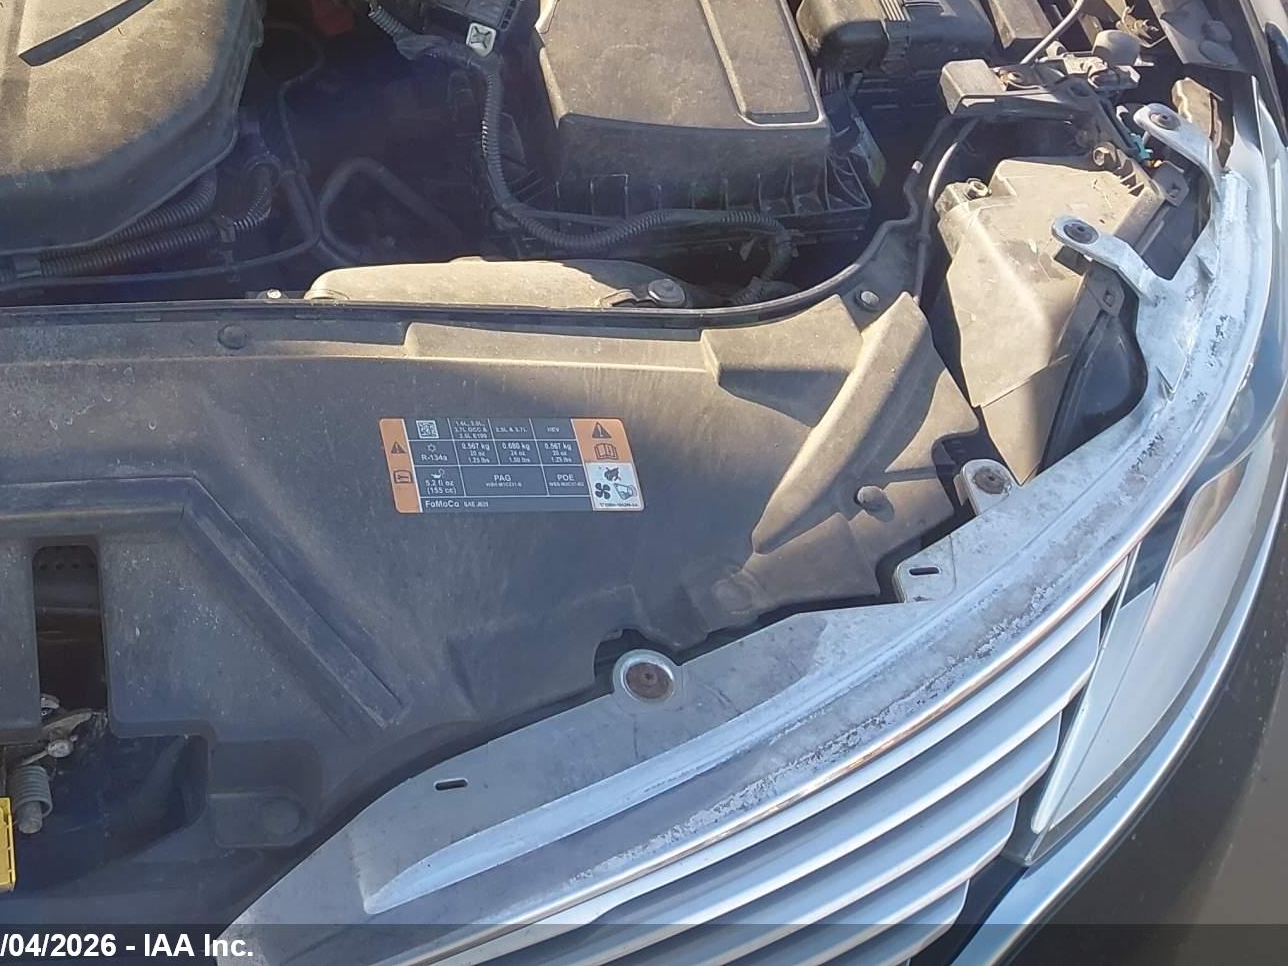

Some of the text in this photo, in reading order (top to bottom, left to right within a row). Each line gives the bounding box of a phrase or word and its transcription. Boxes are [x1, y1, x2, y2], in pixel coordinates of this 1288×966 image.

[481, 442, 490, 451] kg
[521, 442, 531, 450] kg
[562, 442, 572, 450] kg
[494, 474, 512, 482] PAG
[427, 487, 443, 495] (155
[425, 500, 460, 508] FoMoCo
